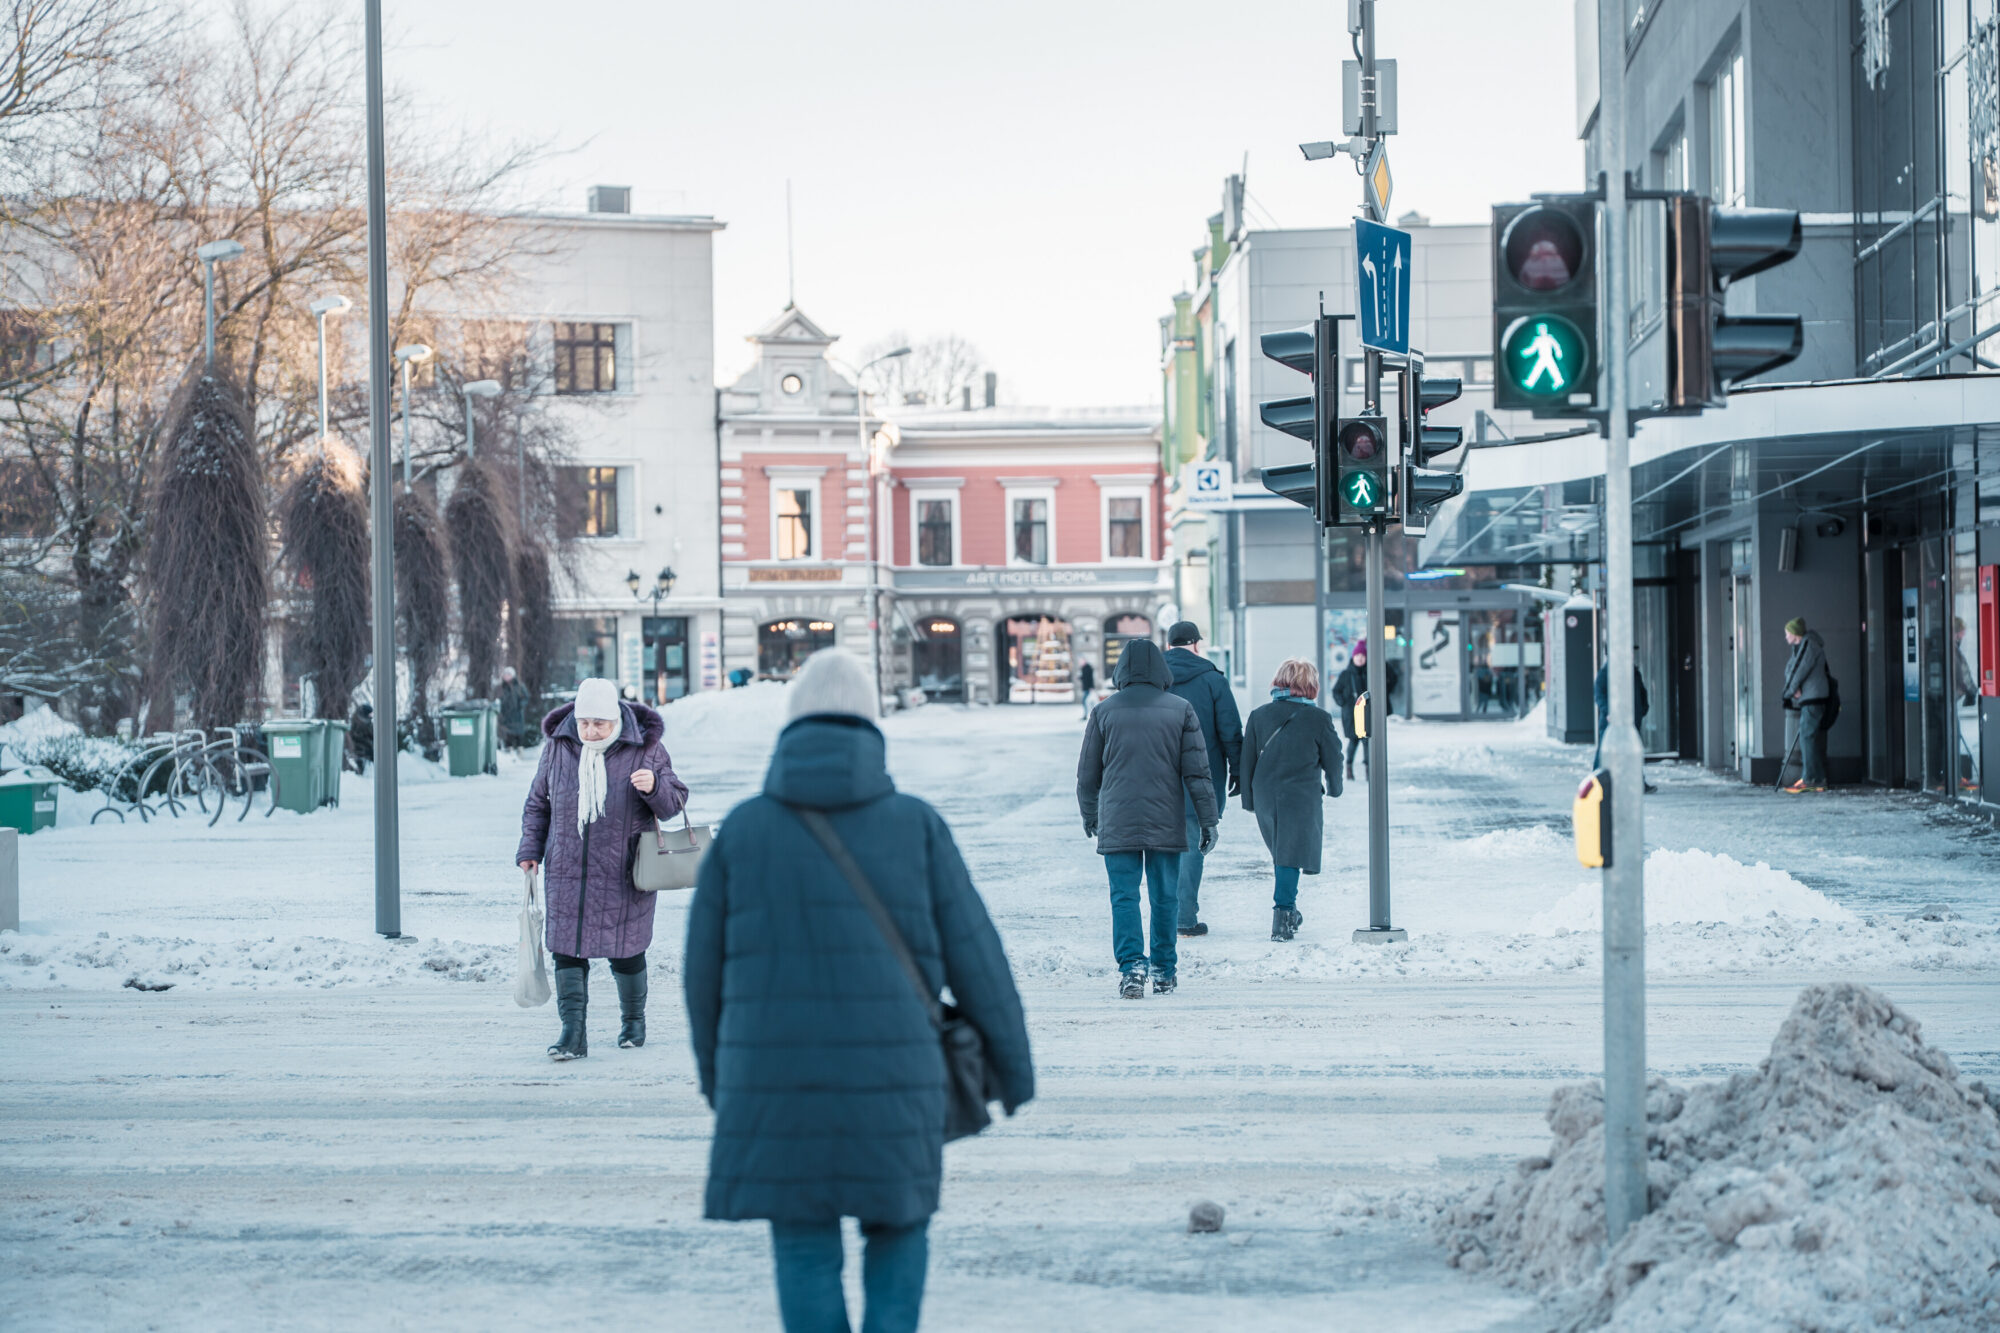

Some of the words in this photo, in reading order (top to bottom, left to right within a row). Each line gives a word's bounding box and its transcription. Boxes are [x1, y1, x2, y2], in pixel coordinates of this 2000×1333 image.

[966, 572, 996, 584] ART
[999, 571, 1050, 584] HOTEL
[1052, 571, 1097, 583] ROMA
